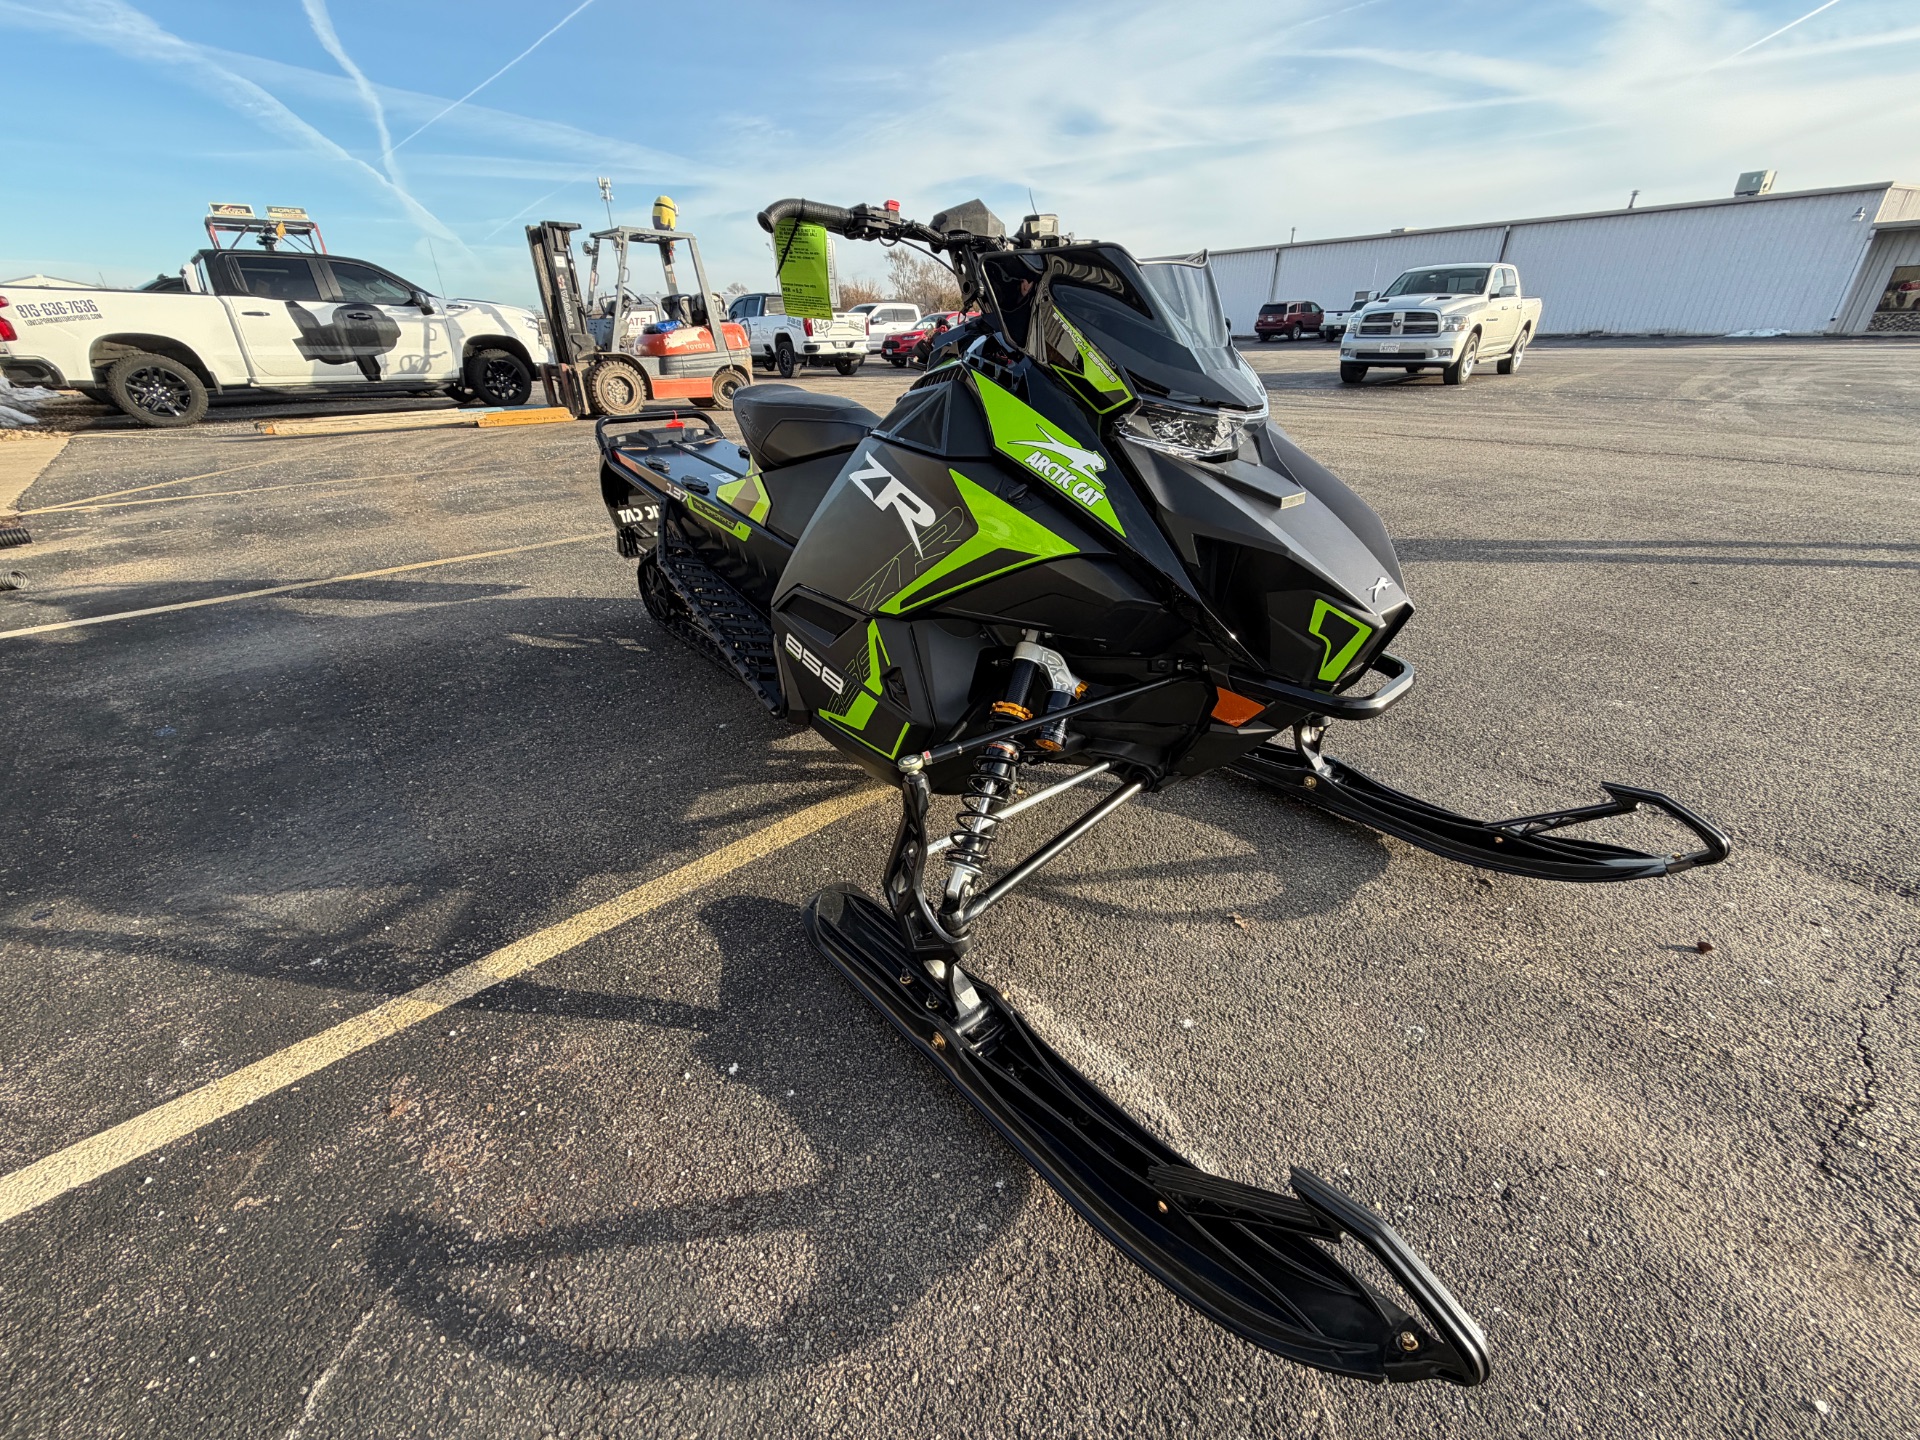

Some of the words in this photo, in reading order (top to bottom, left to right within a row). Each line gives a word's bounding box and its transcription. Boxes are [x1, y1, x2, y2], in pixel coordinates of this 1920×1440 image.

[15, 298, 99, 319] 815-636-7636
[560, 289, 576, 330] TOYOTA
[628, 317, 646, 326] ATE
[685, 342, 711, 351] TOYOTA
[1052, 311, 1088, 351] STEALTH
[1086, 351, 1117, 384] SERIES
[665, 482, 688, 503] 137
[1024, 450, 1078, 490] ARCTIC
[1072, 482, 1105, 507] CAT
[848, 451, 936, 560] ZR
[785, 632, 844, 695] 858
